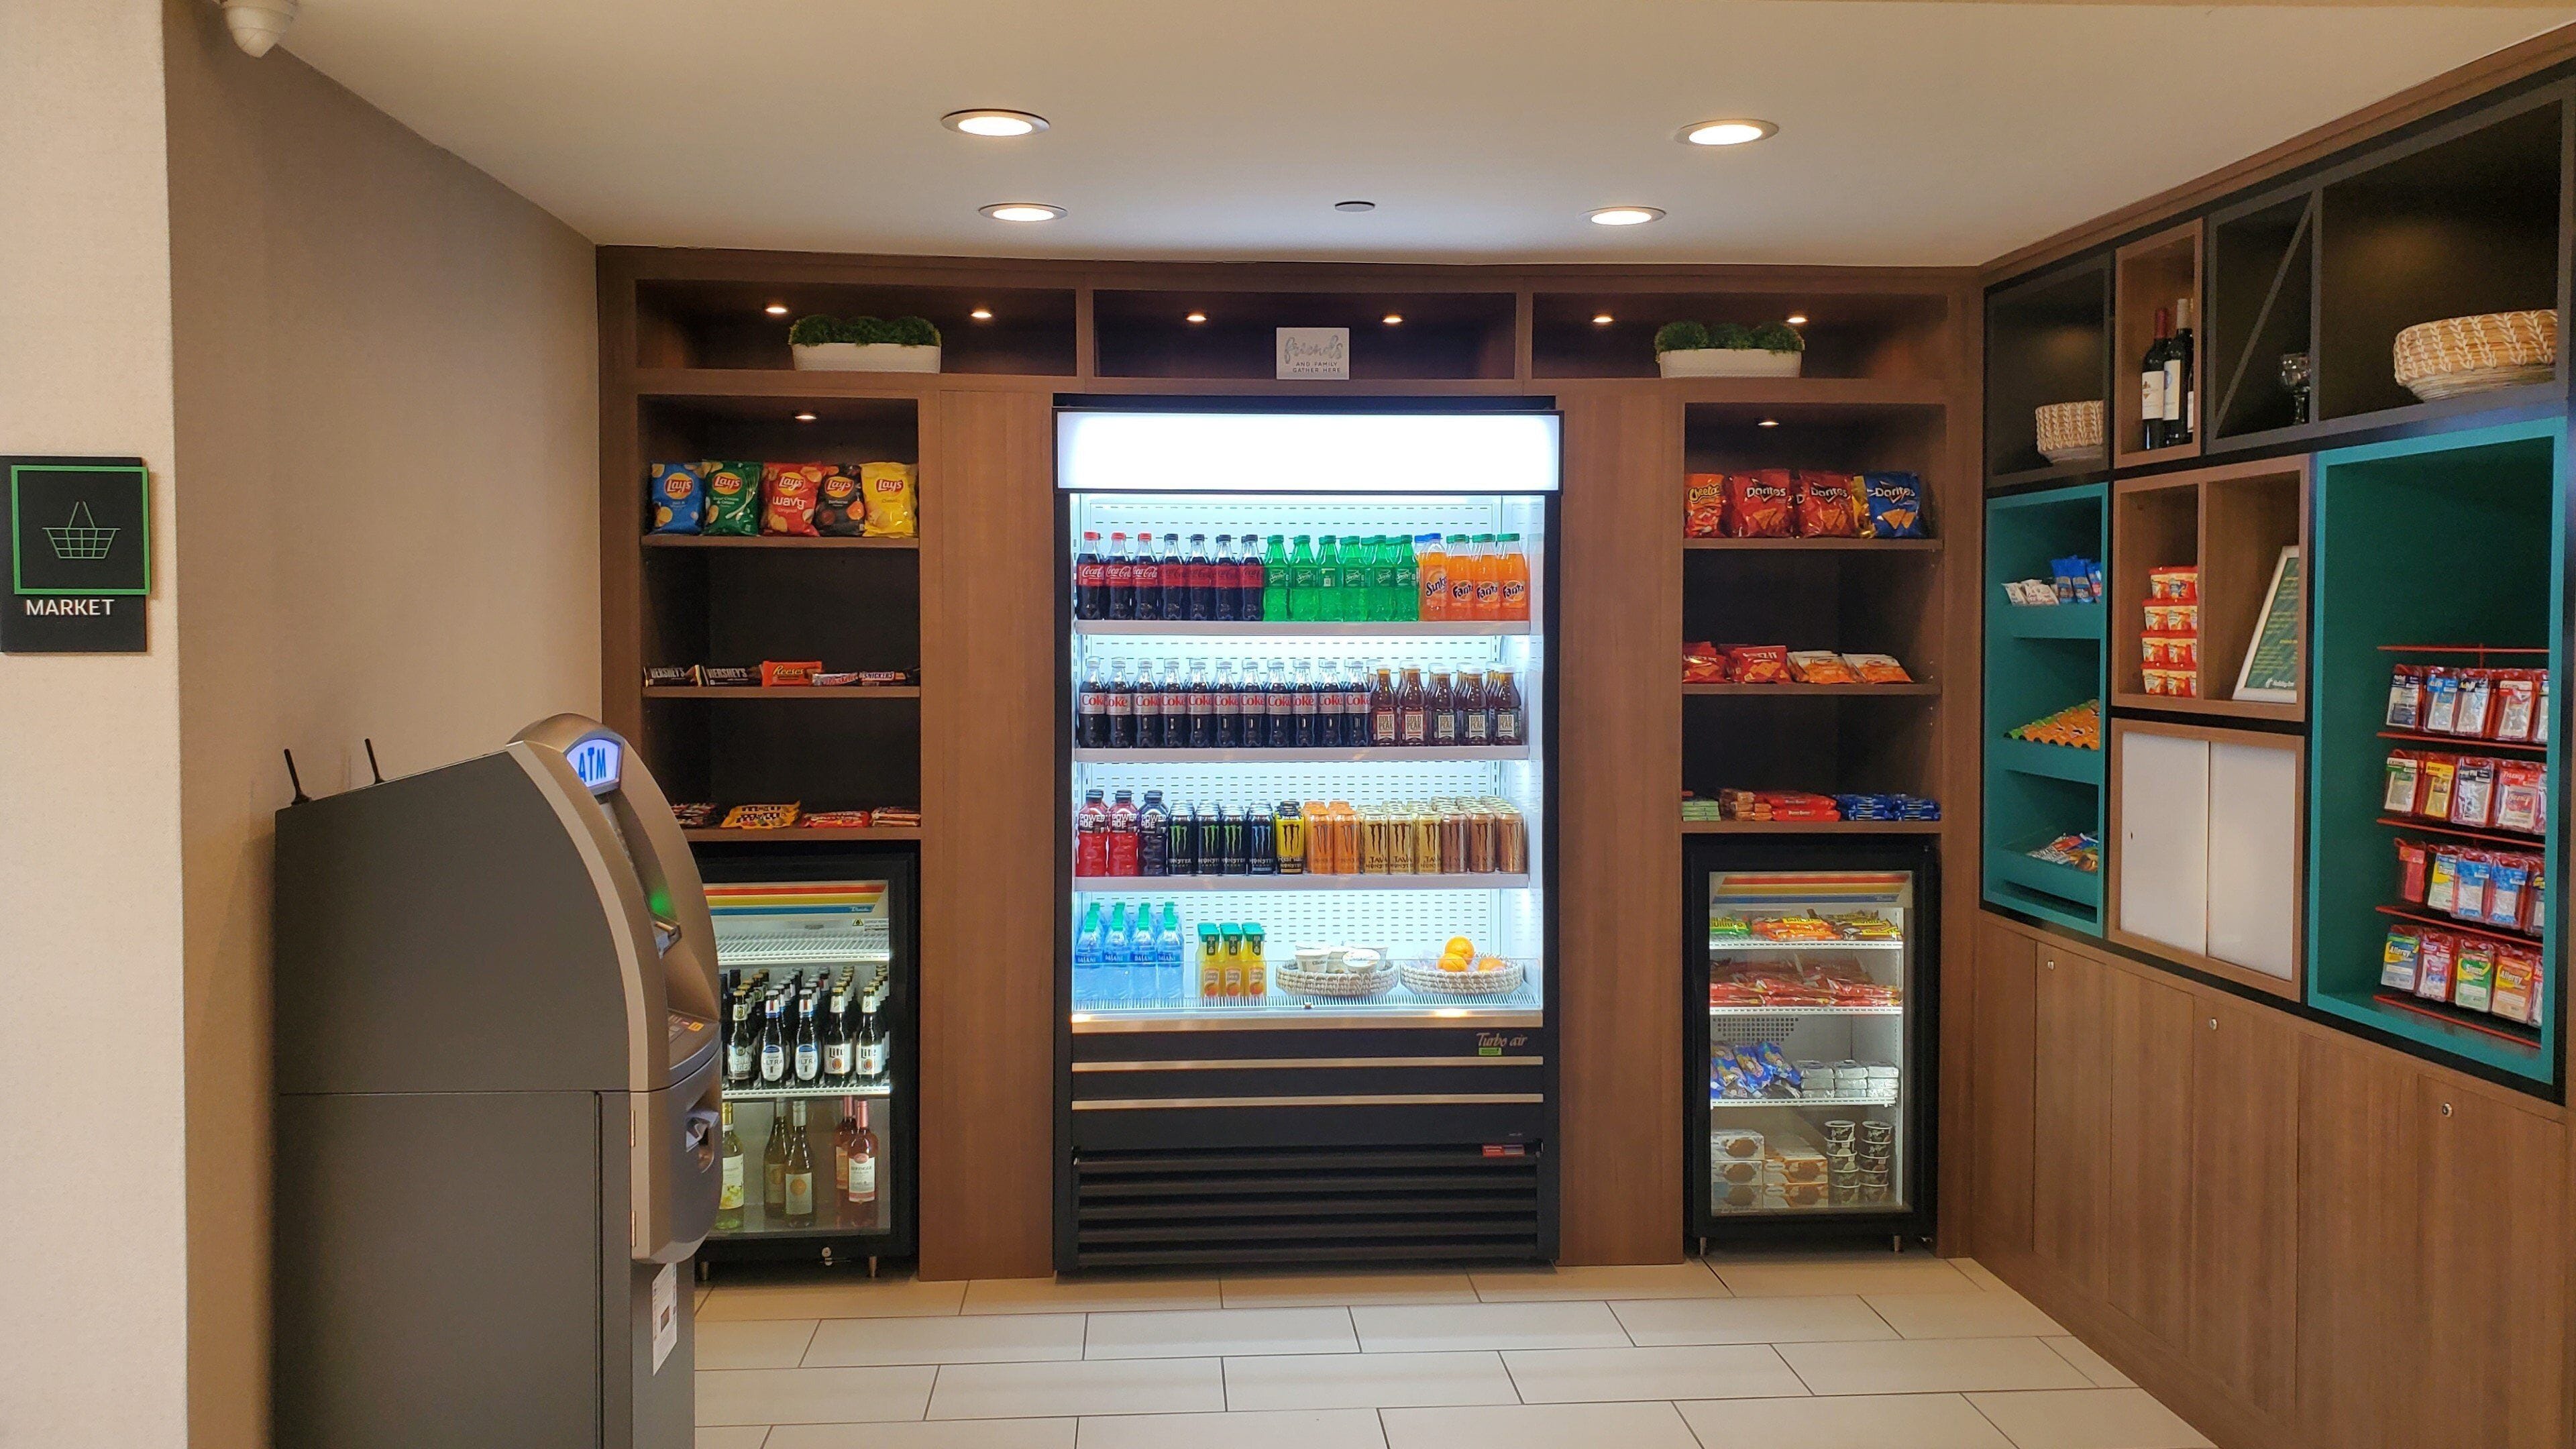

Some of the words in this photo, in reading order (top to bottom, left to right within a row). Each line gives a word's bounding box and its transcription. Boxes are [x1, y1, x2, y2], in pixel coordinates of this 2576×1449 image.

[1746, 487, 1786, 498] Doritos
[1811, 486, 1848, 497] Doritos
[1875, 487, 1915, 497] Doritos
[1477, 584, 1498, 599] Fanta
[1502, 584, 1524, 599] Fanta
[25, 598, 115, 616] MARKET
[706, 667, 748, 679] HERSHEY'S
[1241, 695, 1264, 706] Coke
[1319, 694, 1342, 706] Coke
[1346, 694, 1370, 706] Coke
[578, 747, 606, 782] ATM
[1079, 814, 1106, 822] POWER
[1112, 813, 1137, 822] POWER
[1141, 814, 1166, 822] POWER
[1112, 820, 1126, 828] ADE
[1140, 820, 1155, 828] ADE
[2389, 946, 2412, 957] Allergy
[2500, 970, 2524, 984] Allergy
[1476, 1032, 1507, 1047] Turbo
[1509, 1034, 1528, 1047] air
